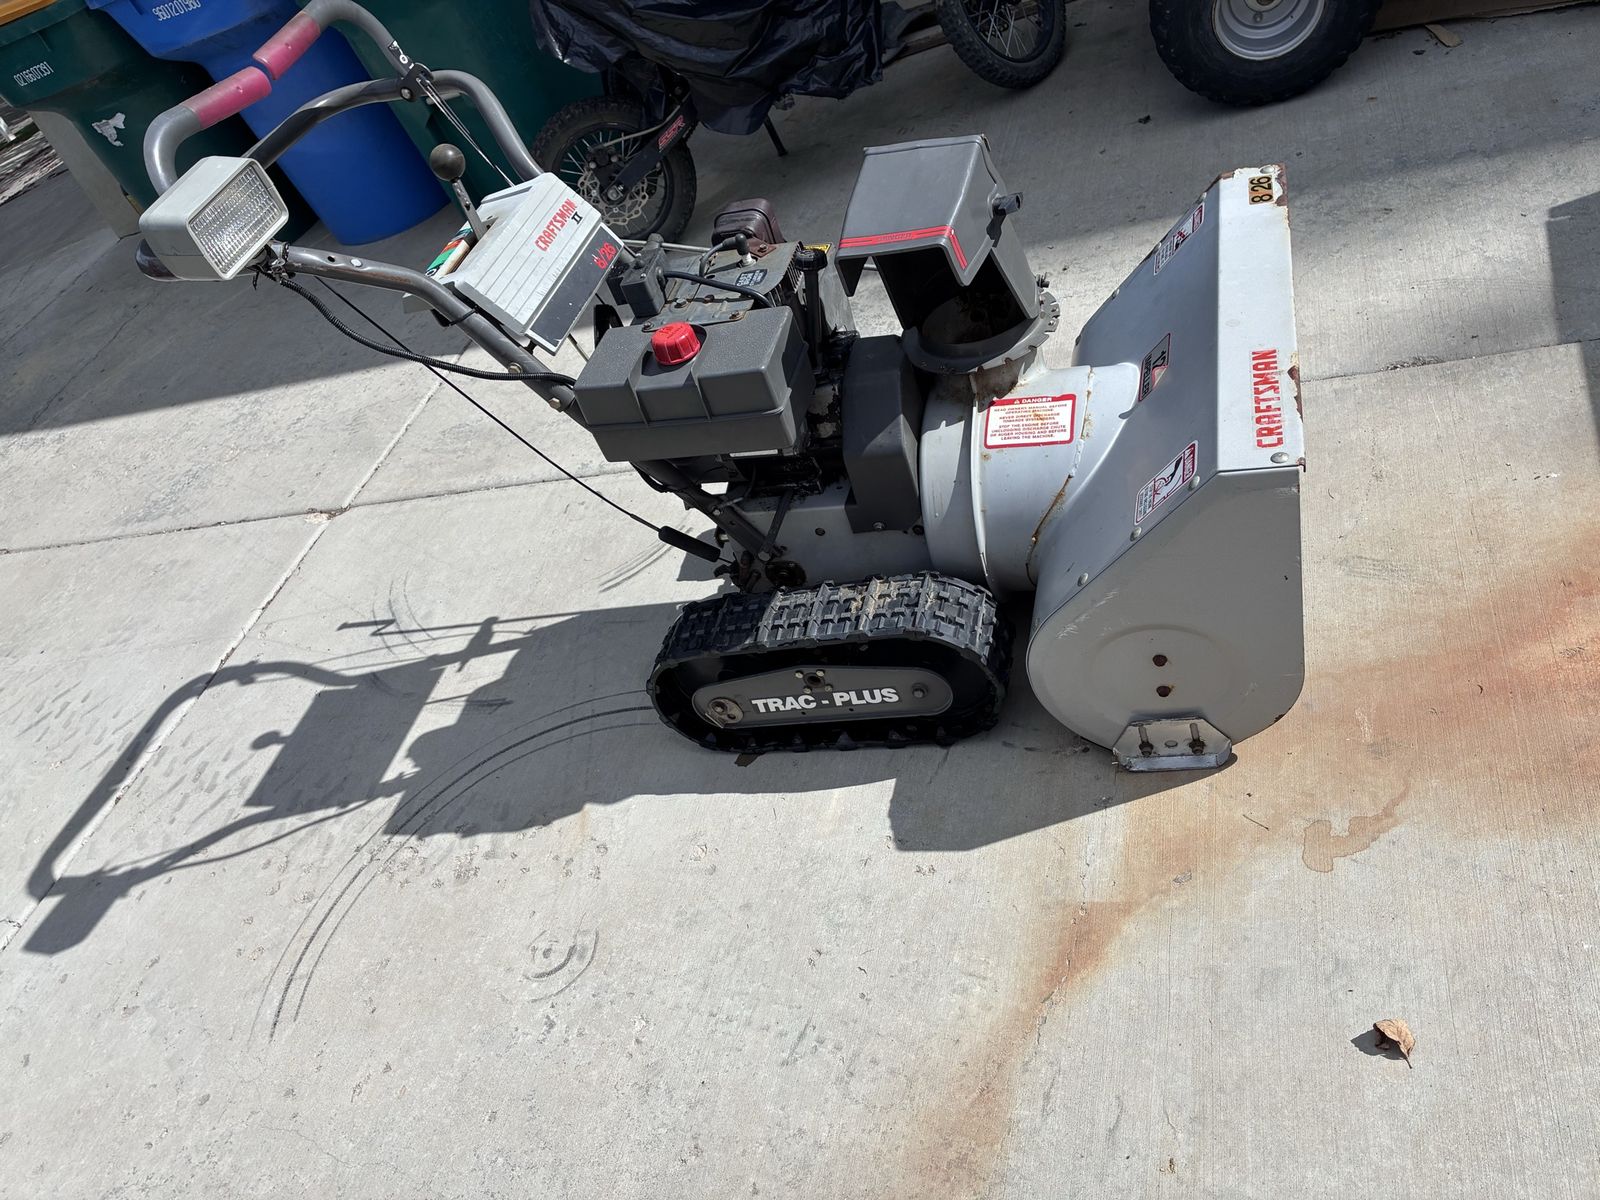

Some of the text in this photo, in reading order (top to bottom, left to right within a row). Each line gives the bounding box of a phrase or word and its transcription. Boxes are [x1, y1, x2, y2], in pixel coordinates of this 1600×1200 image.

[534, 198, 578, 252] CRAFTSMAN
[571, 211, 583, 225] II
[1252, 349, 1284, 449] CRAFTSMAN
[751, 694, 817, 713] TRAC
[832, 688, 900, 706] PLUS
